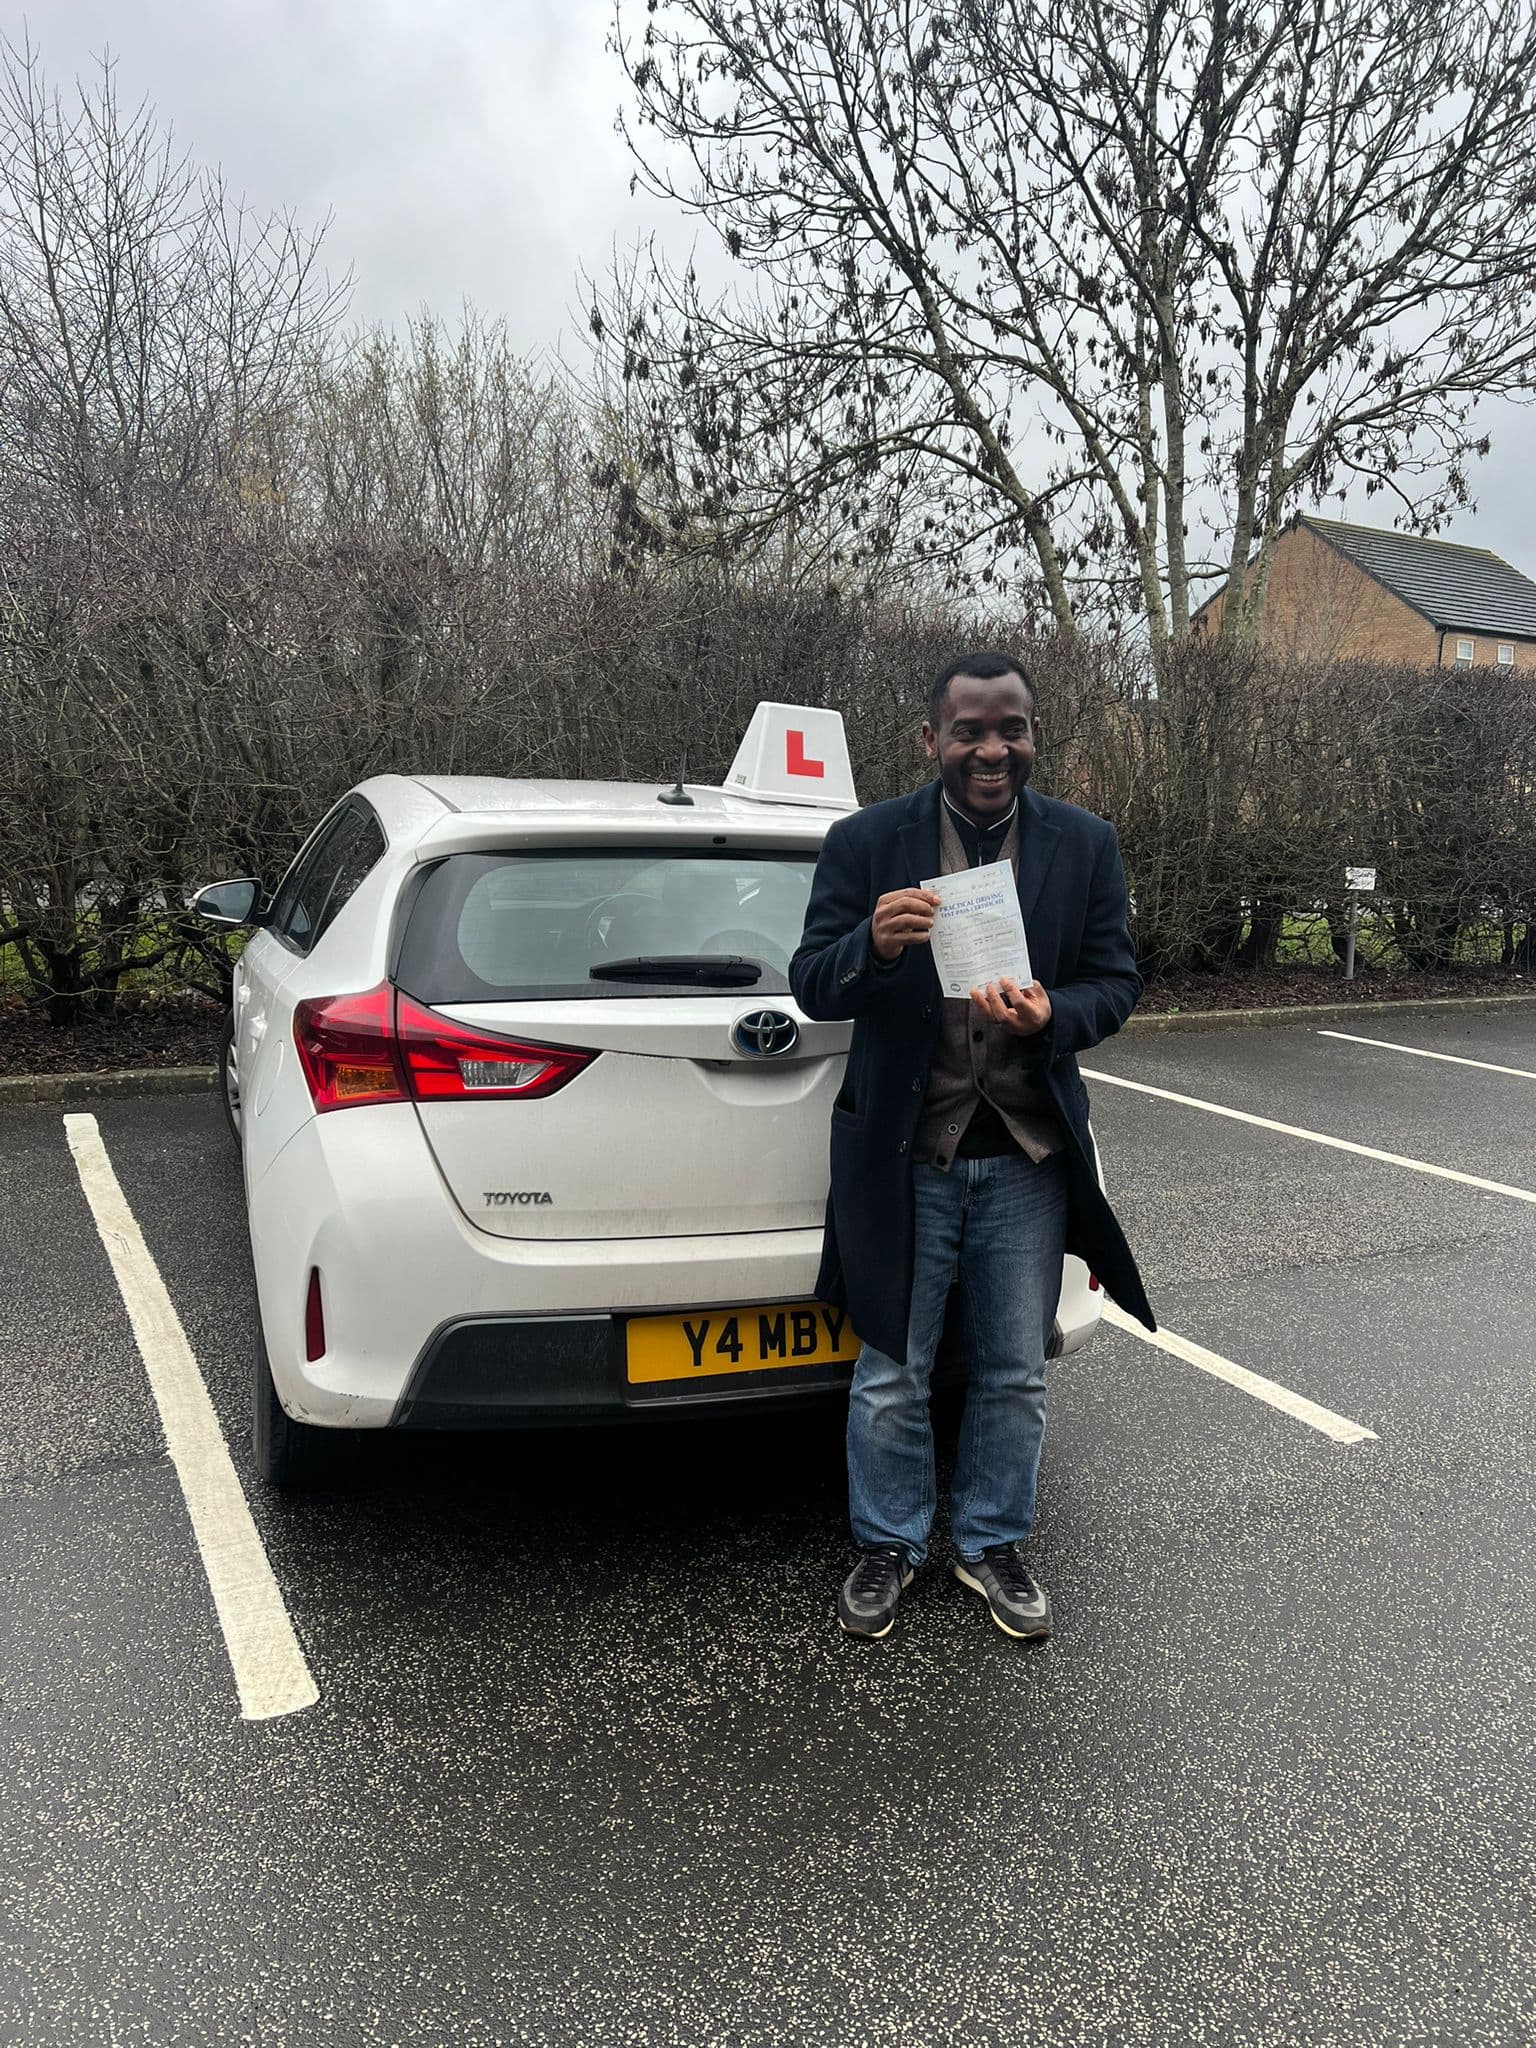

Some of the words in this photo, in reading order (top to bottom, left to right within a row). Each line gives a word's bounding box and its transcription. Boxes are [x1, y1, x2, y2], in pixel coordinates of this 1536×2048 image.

[786, 729, 825, 778] L
[940, 900, 974, 913] PRACTICAL
[975, 892, 1004, 904] DRIVING
[941, 910, 956, 919] TEST
[970, 899, 1004, 912] CERTIFICATE
[483, 1191, 553, 1207] TOYOTA
[683, 1317, 743, 1367] Y4
[758, 1308, 849, 1360] MBY
